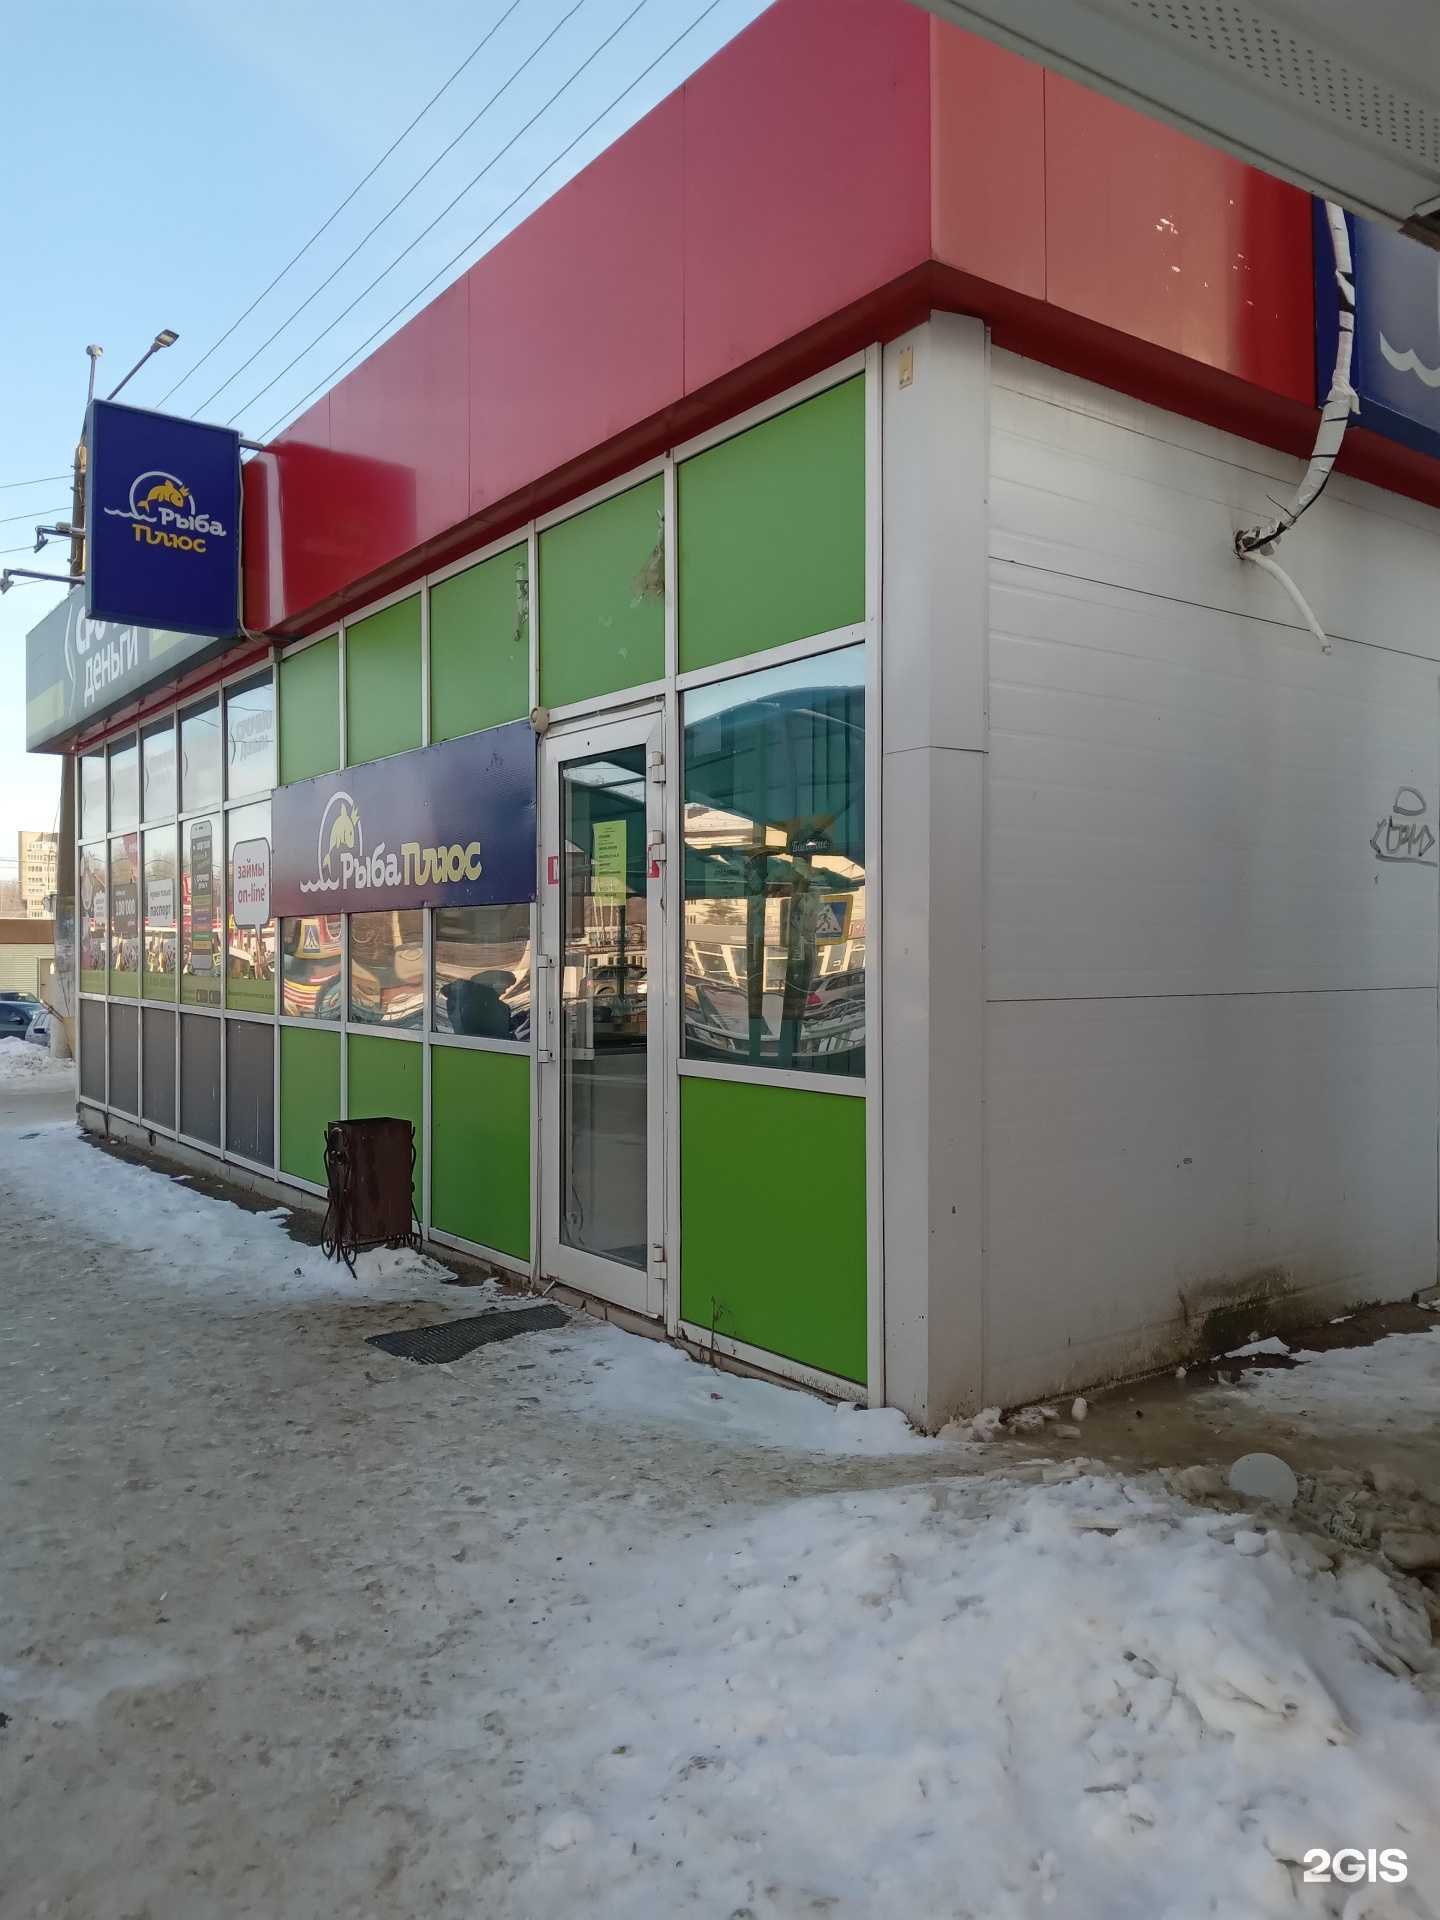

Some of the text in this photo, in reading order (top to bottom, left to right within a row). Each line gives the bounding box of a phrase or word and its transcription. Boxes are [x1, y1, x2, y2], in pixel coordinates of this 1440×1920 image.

[158, 506, 227, 537] Рыба
[131, 523, 207, 553] Плюс
[84, 625, 138, 708] деньги
[237, 858, 265, 879] займы
[340, 841, 482, 889] Рыба Плюс
